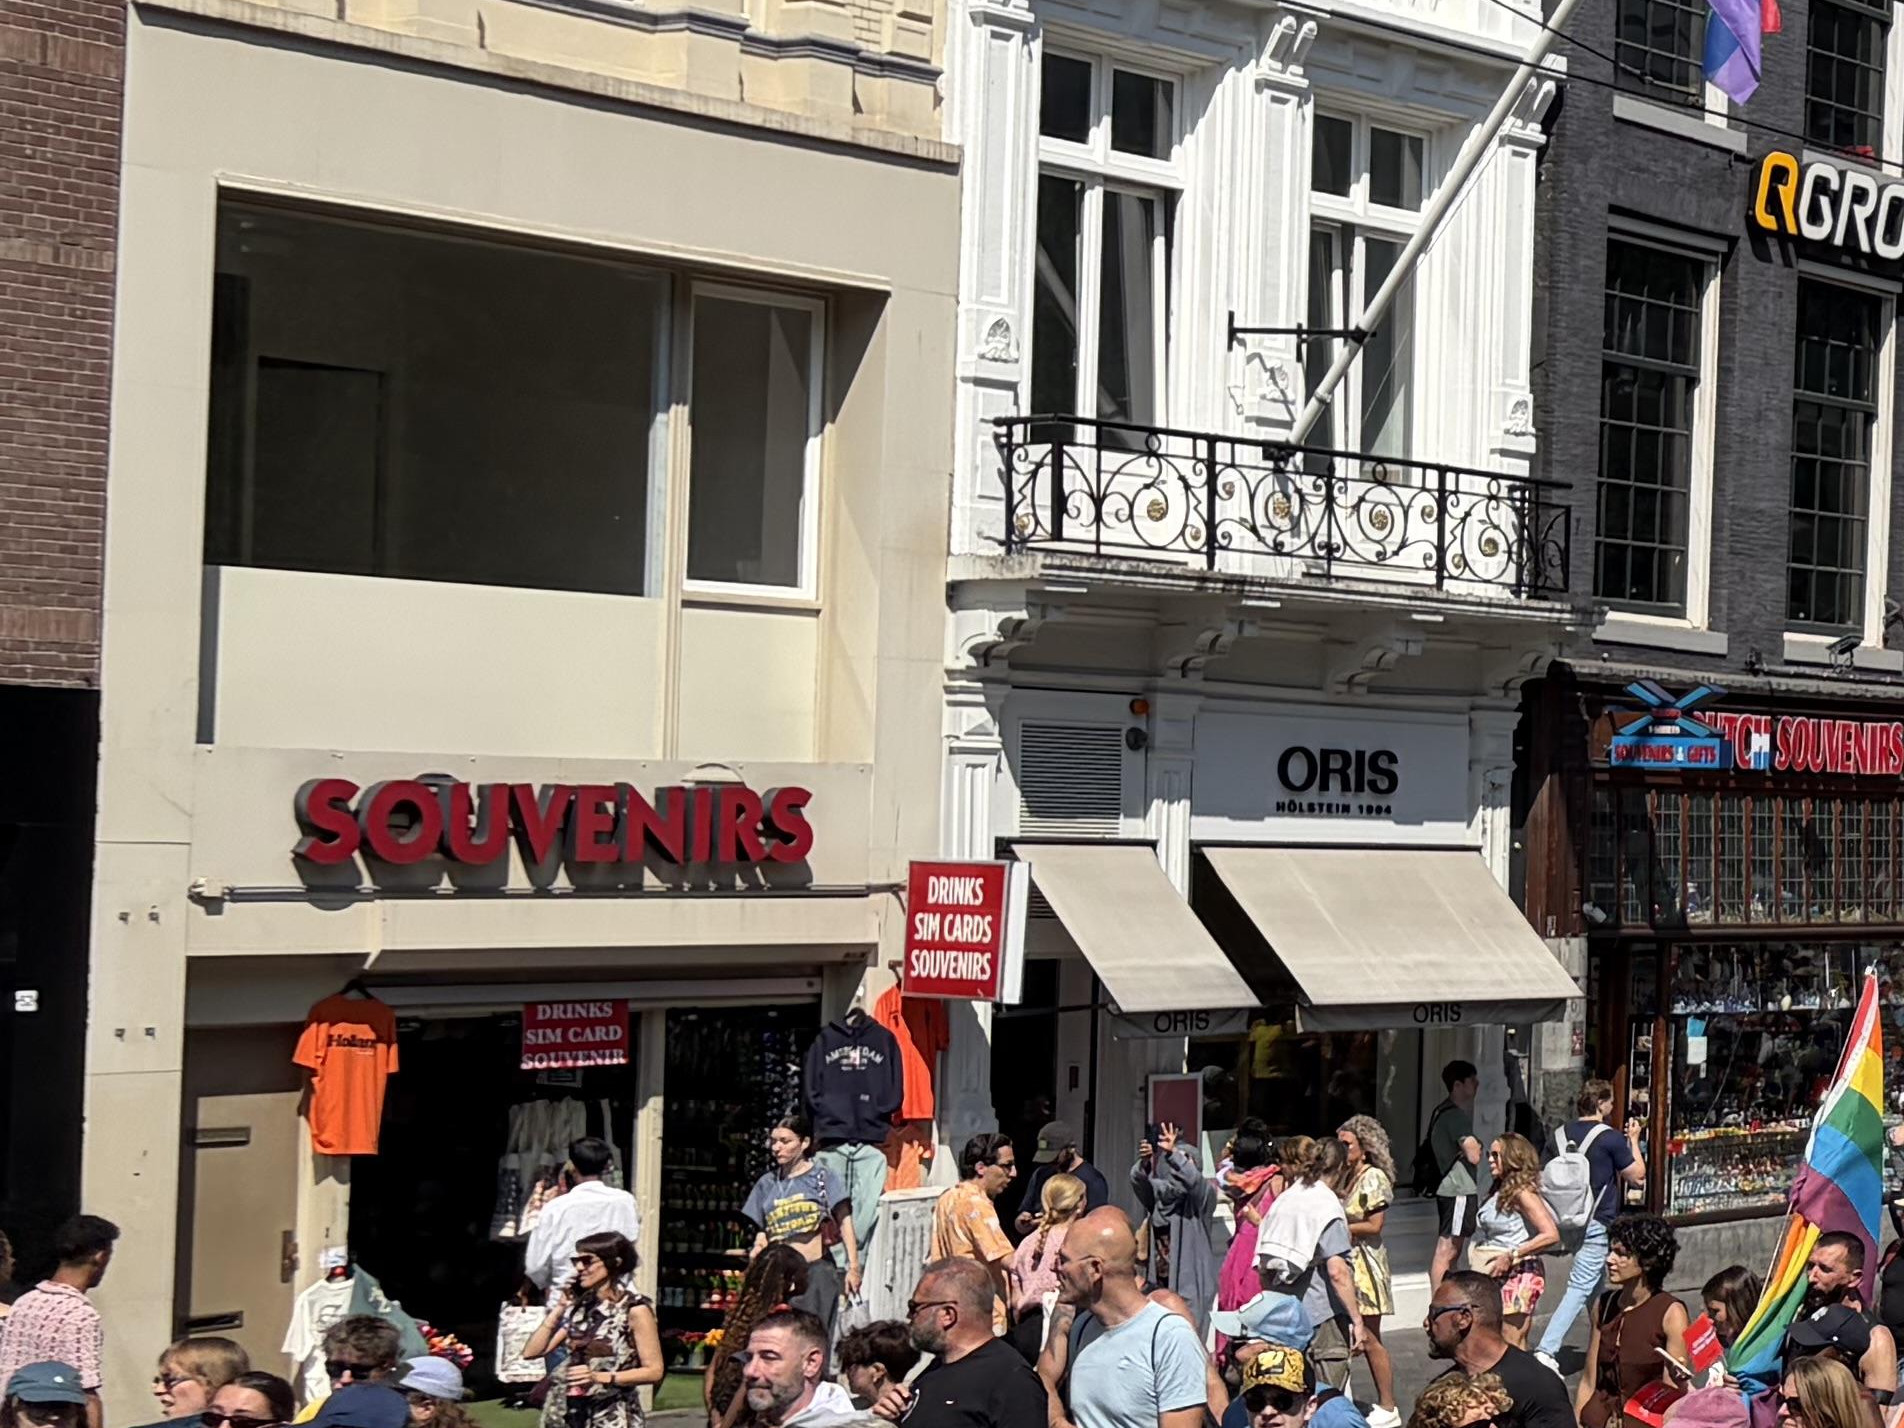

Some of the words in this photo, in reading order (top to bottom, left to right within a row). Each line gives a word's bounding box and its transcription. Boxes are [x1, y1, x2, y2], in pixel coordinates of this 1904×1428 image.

[1687, 744, 1717, 764] GIFTS
[1773, 715, 1904, 775] SOUVENIRS
[1277, 745, 1399, 795] ORIS
[1276, 798, 1351, 815] HÖLSTEIN
[302, 778, 815, 866] SOUVENIRS
[927, 875, 985, 906] DRINKS
[914, 912, 942, 942] SIM
[943, 913, 993, 944] CARDS
[910, 949, 992, 981] SOUVENIRS
[536, 1002, 613, 1020] DRINKS
[1153, 1010, 1210, 1033] ORIS
[1413, 1003, 1462, 1024] ORIS
[525, 1027, 562, 1044] SIM
[567, 1025, 623, 1042] CARD
[520, 1048, 627, 1069] SOUVENIR
